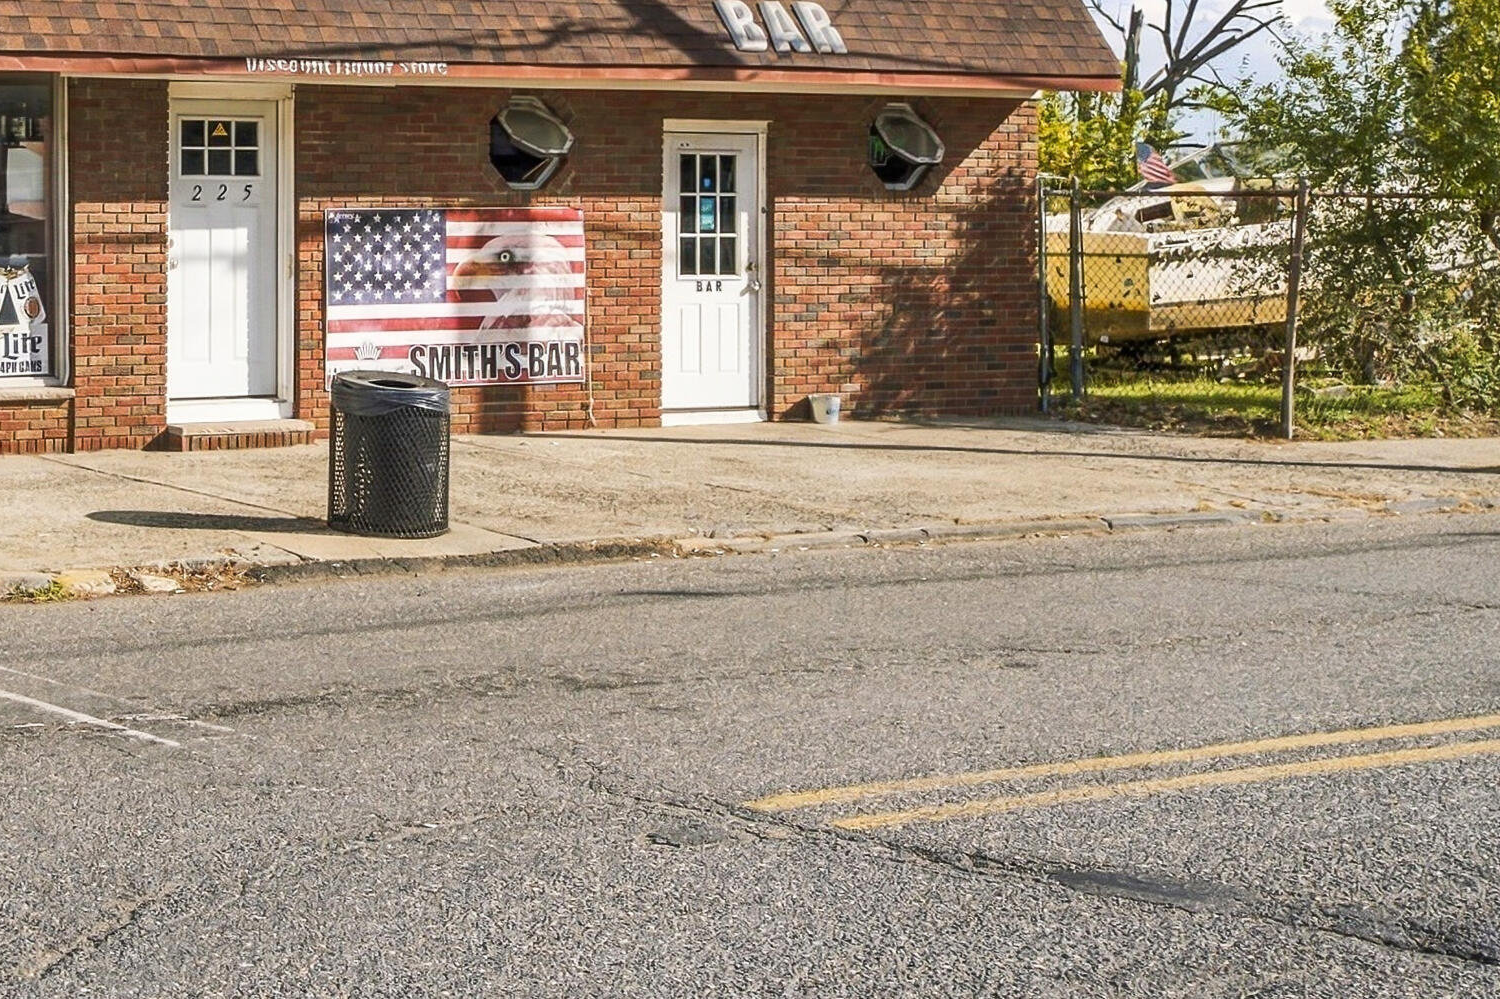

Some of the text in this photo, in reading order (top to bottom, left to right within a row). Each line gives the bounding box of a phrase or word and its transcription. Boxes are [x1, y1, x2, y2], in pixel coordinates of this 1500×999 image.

[696, 280, 723, 292] BAR
[1, 333, 43, 360] Lite
[408, 339, 582, 381] SMITH'S BAR
